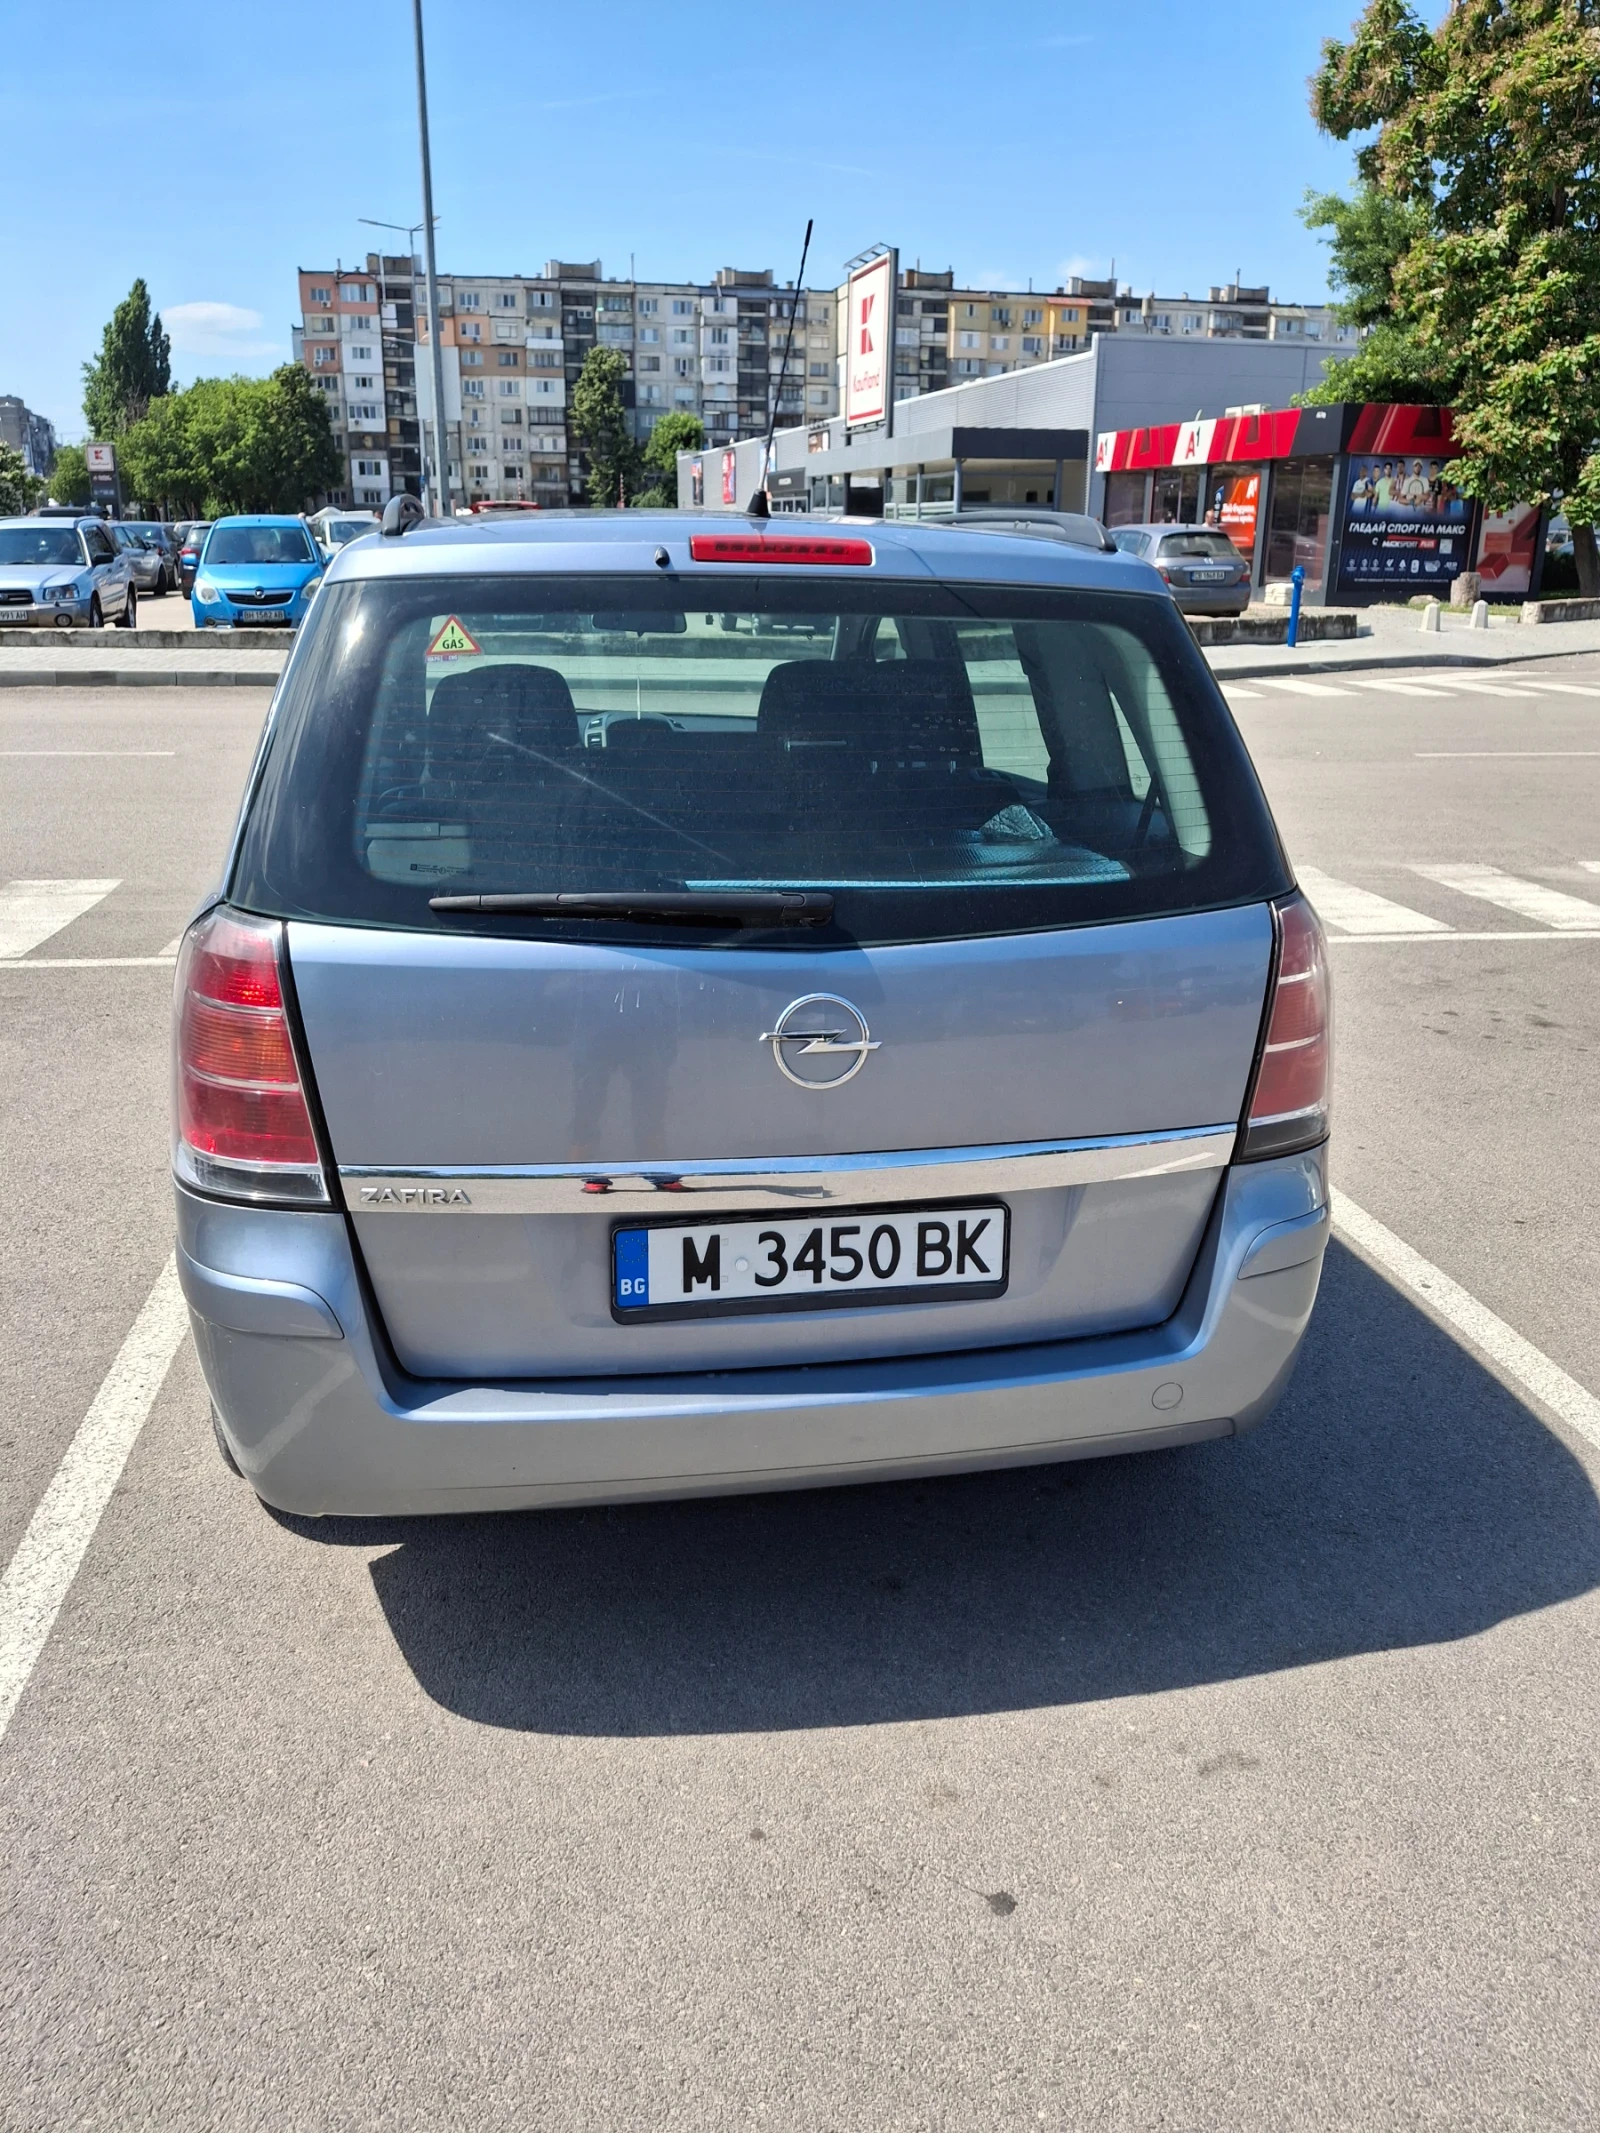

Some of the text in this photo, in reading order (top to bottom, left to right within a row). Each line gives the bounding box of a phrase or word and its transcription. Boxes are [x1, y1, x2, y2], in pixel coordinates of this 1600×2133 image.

[1185, 426, 1201, 459] A1
[1348, 521, 1467, 535] ГЛЕДАЙ СПОРТ НА МАКС
[442, 638, 464, 649] GAS
[360, 1187, 472, 1204] ZAFIRA
[682, 1218, 992, 1293] M 3450 BK
[620, 1278, 646, 1296] BG
